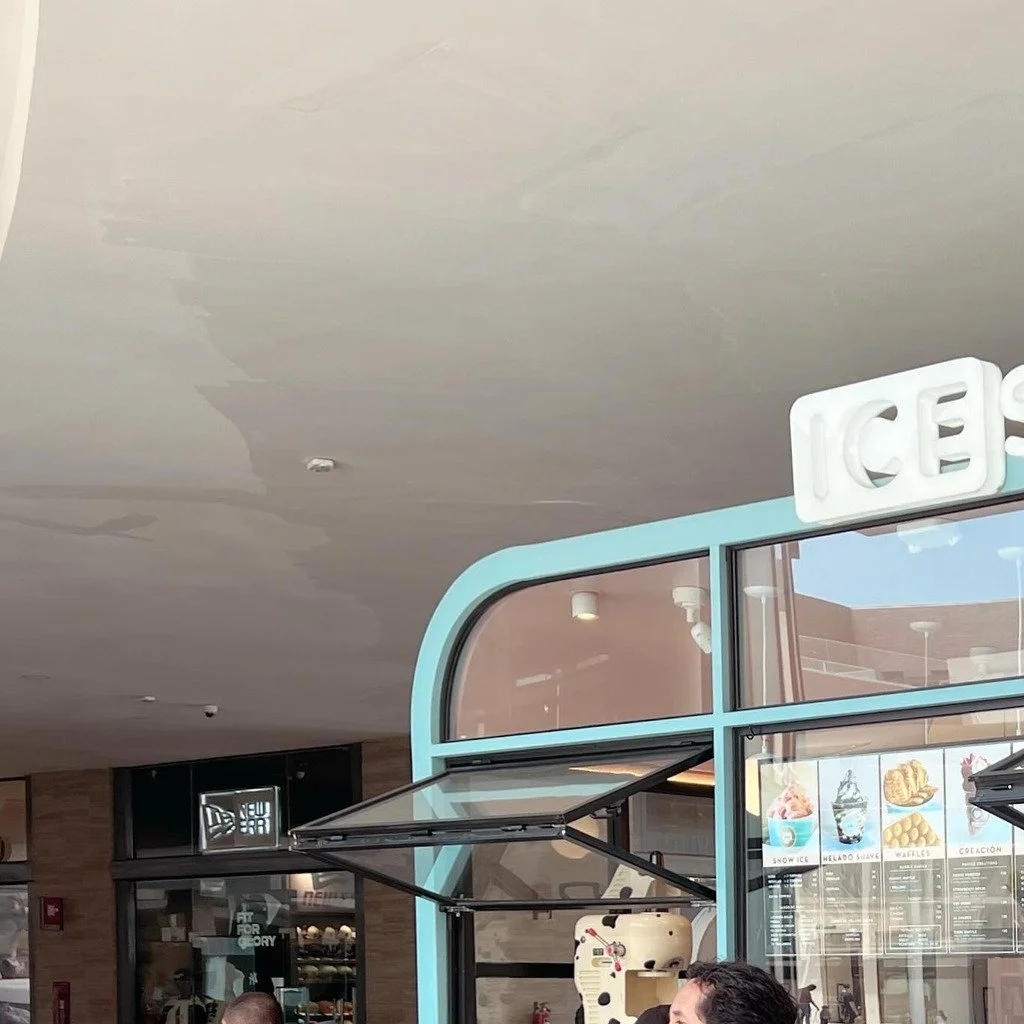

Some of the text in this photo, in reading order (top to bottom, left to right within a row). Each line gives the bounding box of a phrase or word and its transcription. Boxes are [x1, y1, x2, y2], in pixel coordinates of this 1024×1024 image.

[239, 801, 271, 819] NEW
[239, 819, 271, 835] ERA
[959, 846, 1002, 854] CREACIÓN
[856, 853, 880, 861] SUAVE
[236, 911, 254, 924] FIT
[236, 924, 261, 935] FOR
[237, 935, 277, 948] GLORY
